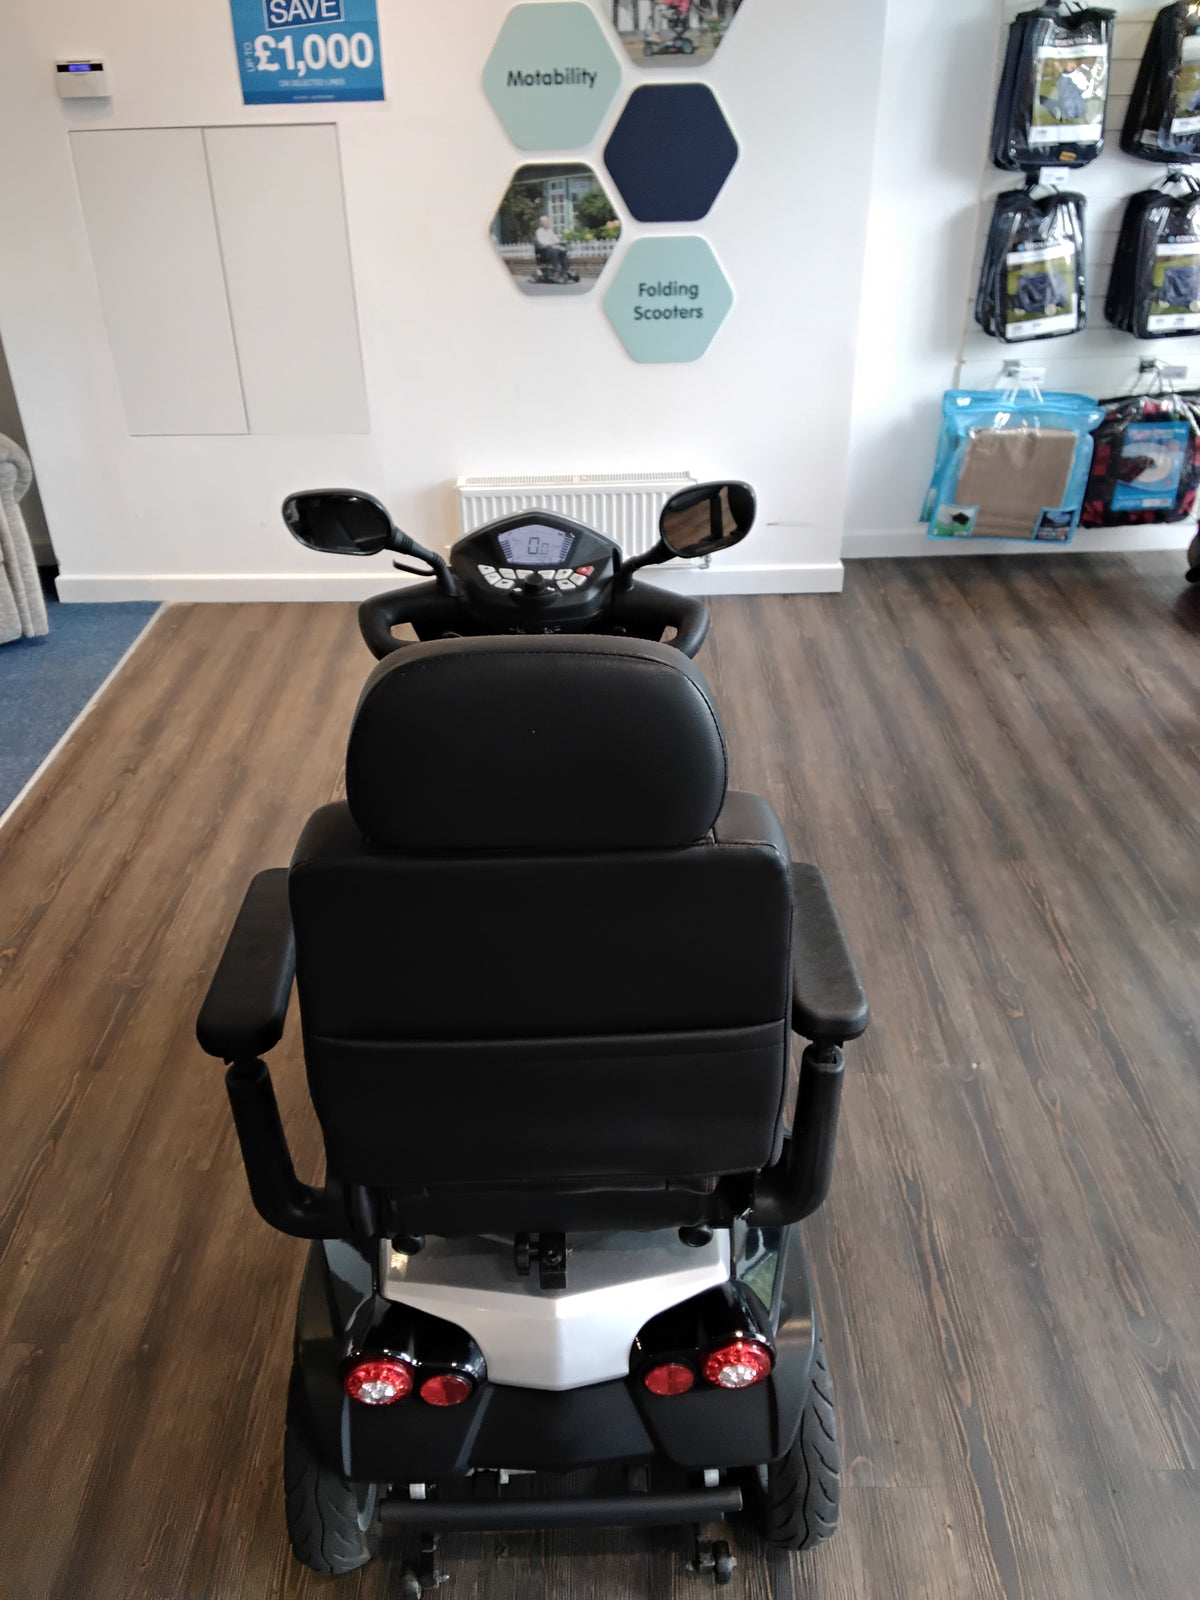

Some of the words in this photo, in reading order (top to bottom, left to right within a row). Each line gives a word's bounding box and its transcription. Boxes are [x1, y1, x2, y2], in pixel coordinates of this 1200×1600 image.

[269, 0, 338, 24] SAVE
[254, 32, 374, 77] £1,000
[506, 67, 598, 88] Motability
[638, 281, 699, 299] Folding
[634, 305, 704, 321] Scooters
